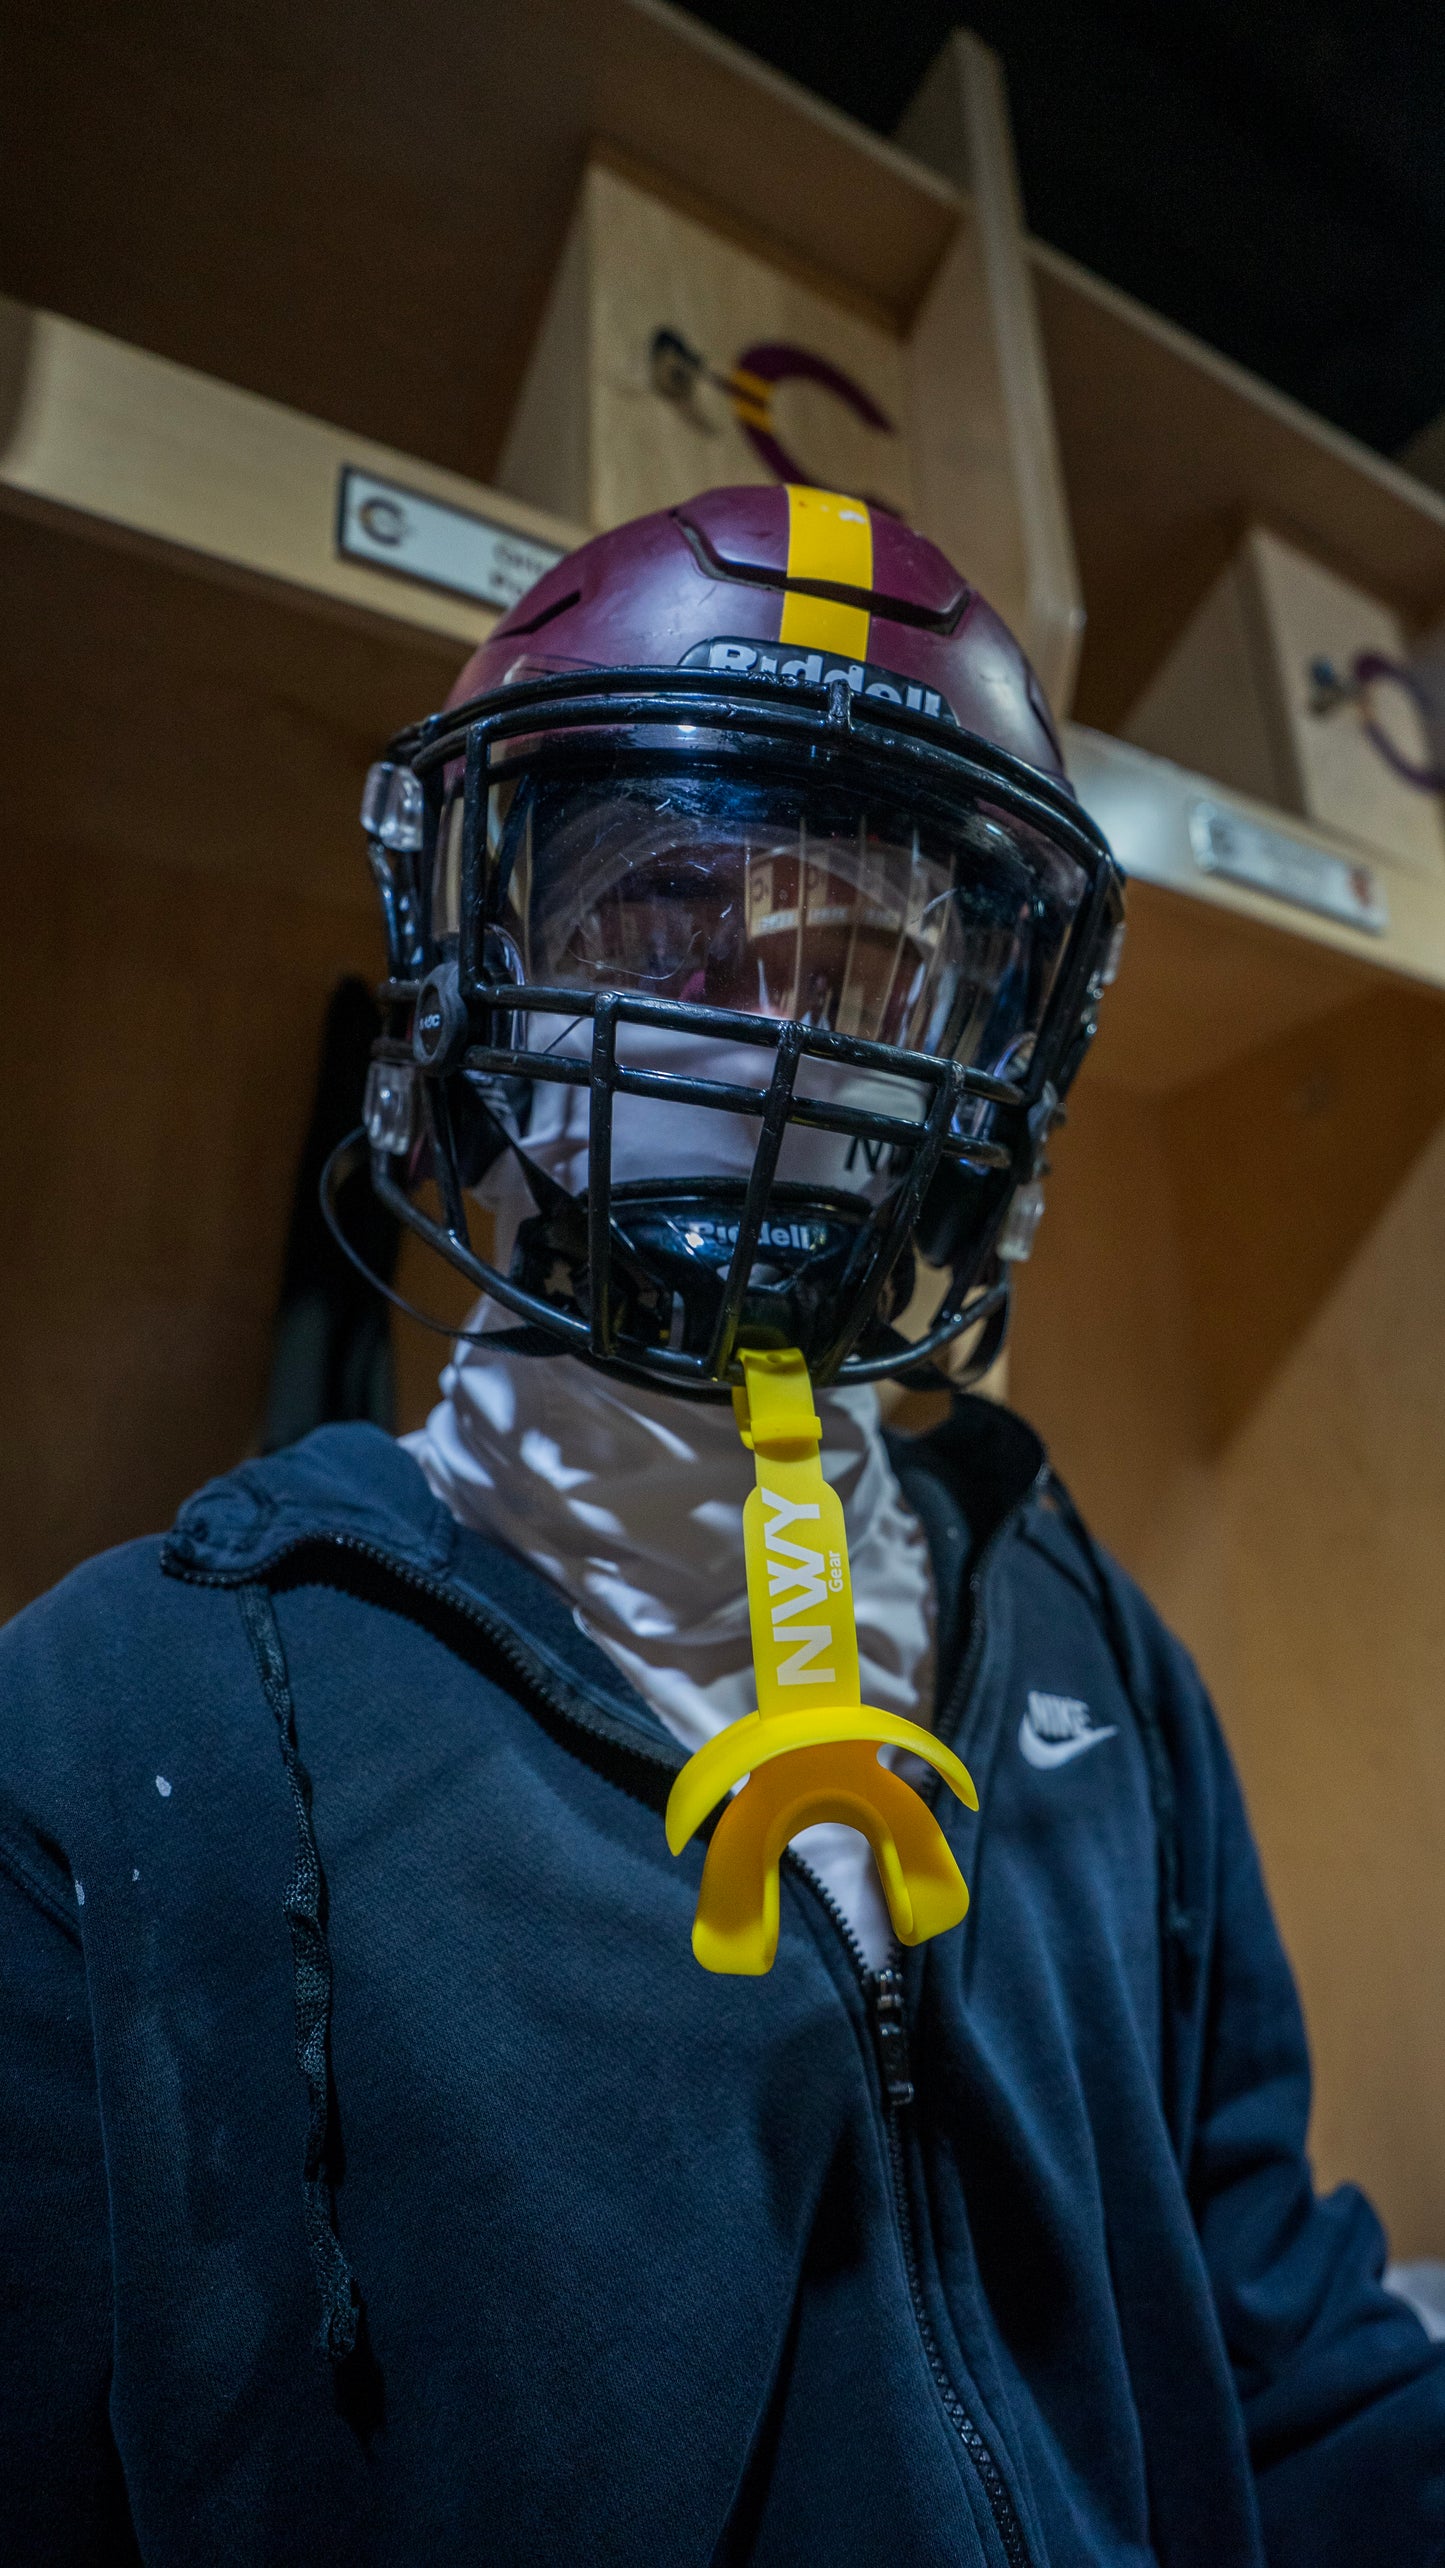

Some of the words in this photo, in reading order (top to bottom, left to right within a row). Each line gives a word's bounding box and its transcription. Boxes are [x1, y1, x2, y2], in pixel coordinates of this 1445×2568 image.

[761, 1486, 836, 1686] NWY
[828, 1550, 844, 1592] Gear
[1027, 1690, 1092, 1738] NIKE
